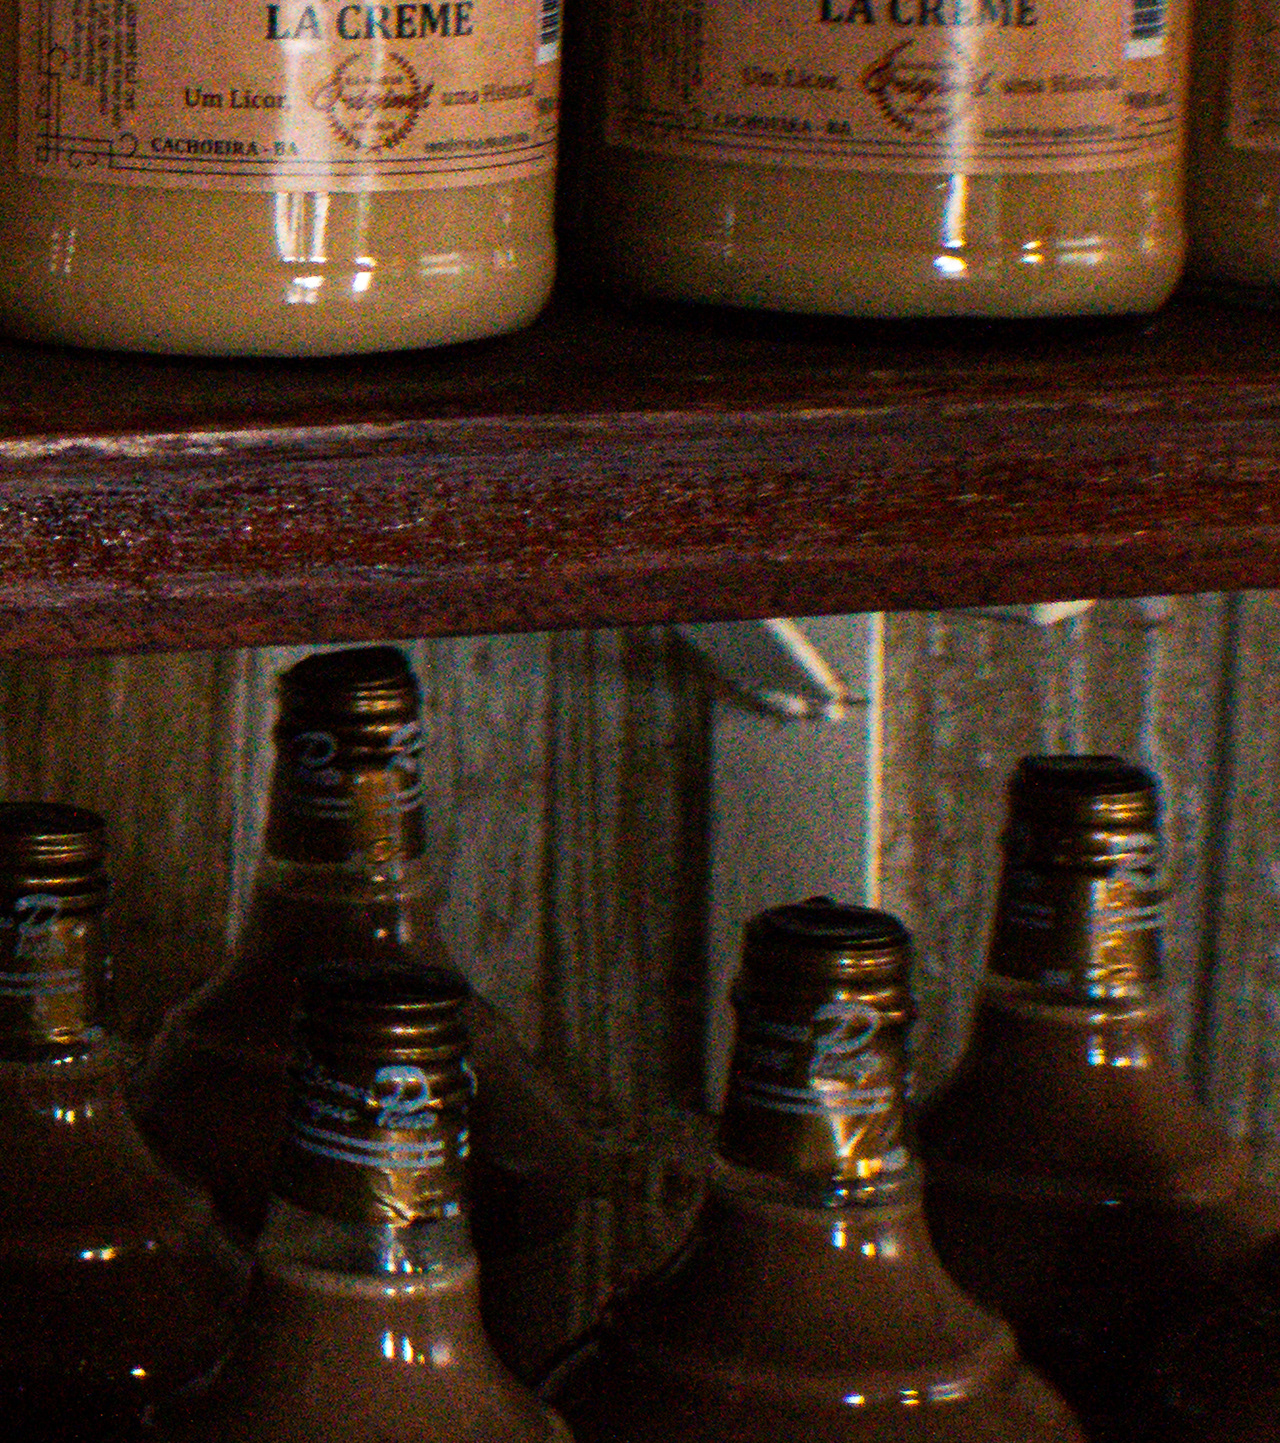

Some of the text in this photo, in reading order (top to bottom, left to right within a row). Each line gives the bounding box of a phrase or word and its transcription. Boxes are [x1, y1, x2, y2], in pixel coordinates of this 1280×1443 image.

[265, 0, 475, 41] LA CREME
[183, 87, 222, 109] Um
[150, 136, 259, 156] CACHOEIRA
